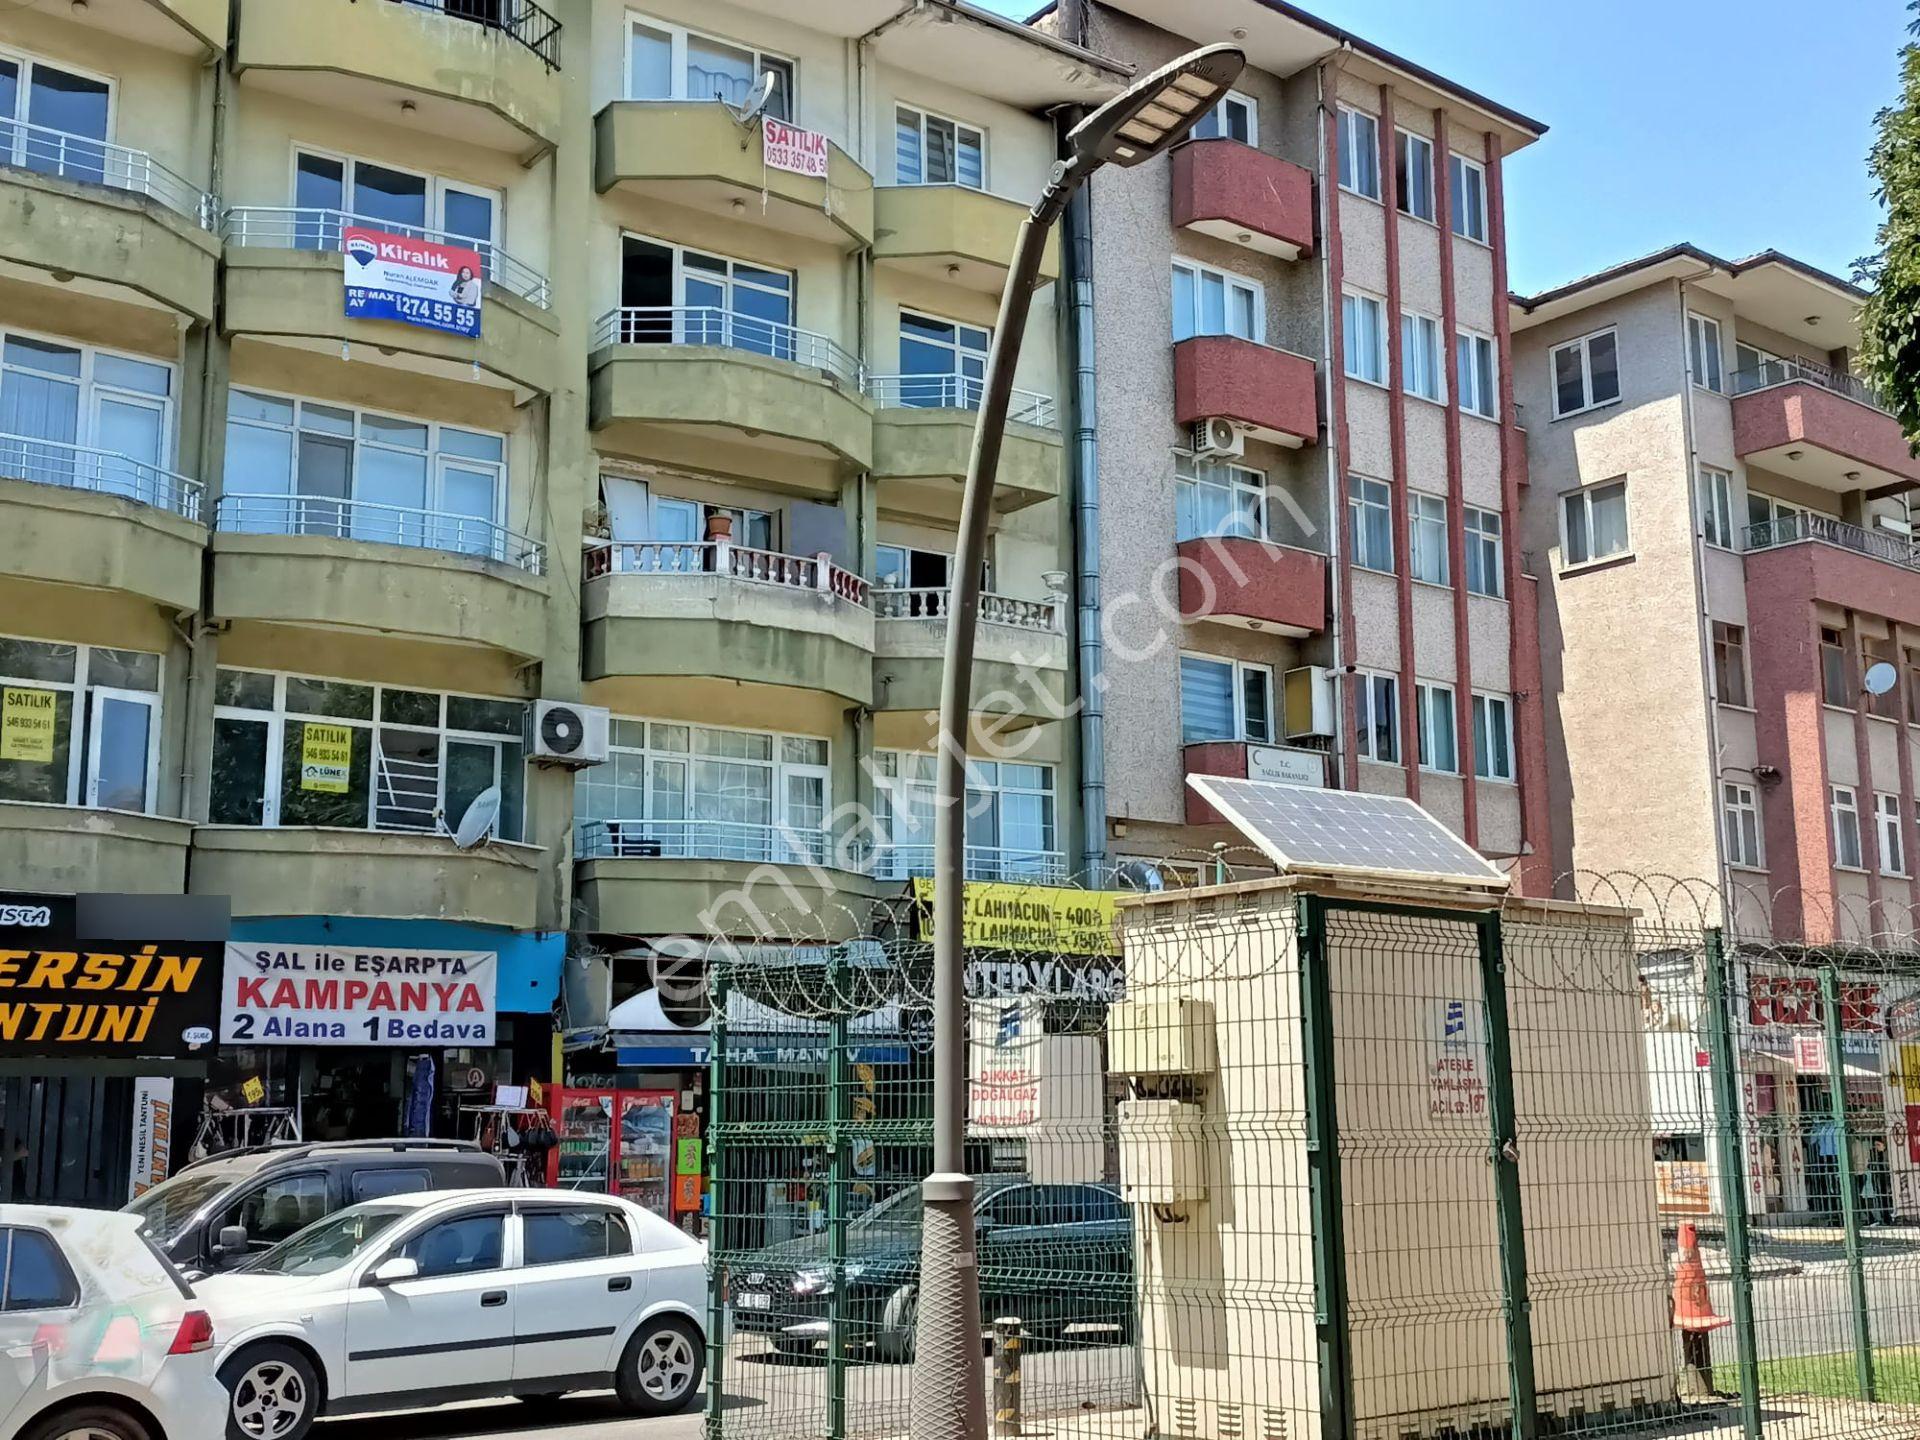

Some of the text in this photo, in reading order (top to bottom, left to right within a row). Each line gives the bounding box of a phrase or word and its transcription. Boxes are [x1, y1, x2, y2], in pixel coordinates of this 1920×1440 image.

[766, 121, 826, 155] SATILIK
[766, 145, 788, 165] 0533
[381, 242, 449, 269] Kiralık
[348, 289, 395, 302] RE/MAX
[402, 296, 430, 317] 274
[433, 302, 453, 322] 55
[456, 308, 475, 327] 55
[350, 299, 366, 308] AY
[8, 692, 52, 709] SATILIK
[306, 727, 347, 744] SATILIK
[0, 907, 47, 924] STA
[975, 897, 1051, 924] LAHMACUN
[256, 951, 467, 977] ŞAL ile EŞARPTA
[237, 977, 485, 1012] KAMPANYA
[232, 1014, 486, 1041] 2 Alana 1 Bedava
[777, 1047, 861, 1063] MANV
[1437, 1059, 1474, 1074] ATEŞLE
[1431, 1079, 1484, 1093] YAKLAŞMA
